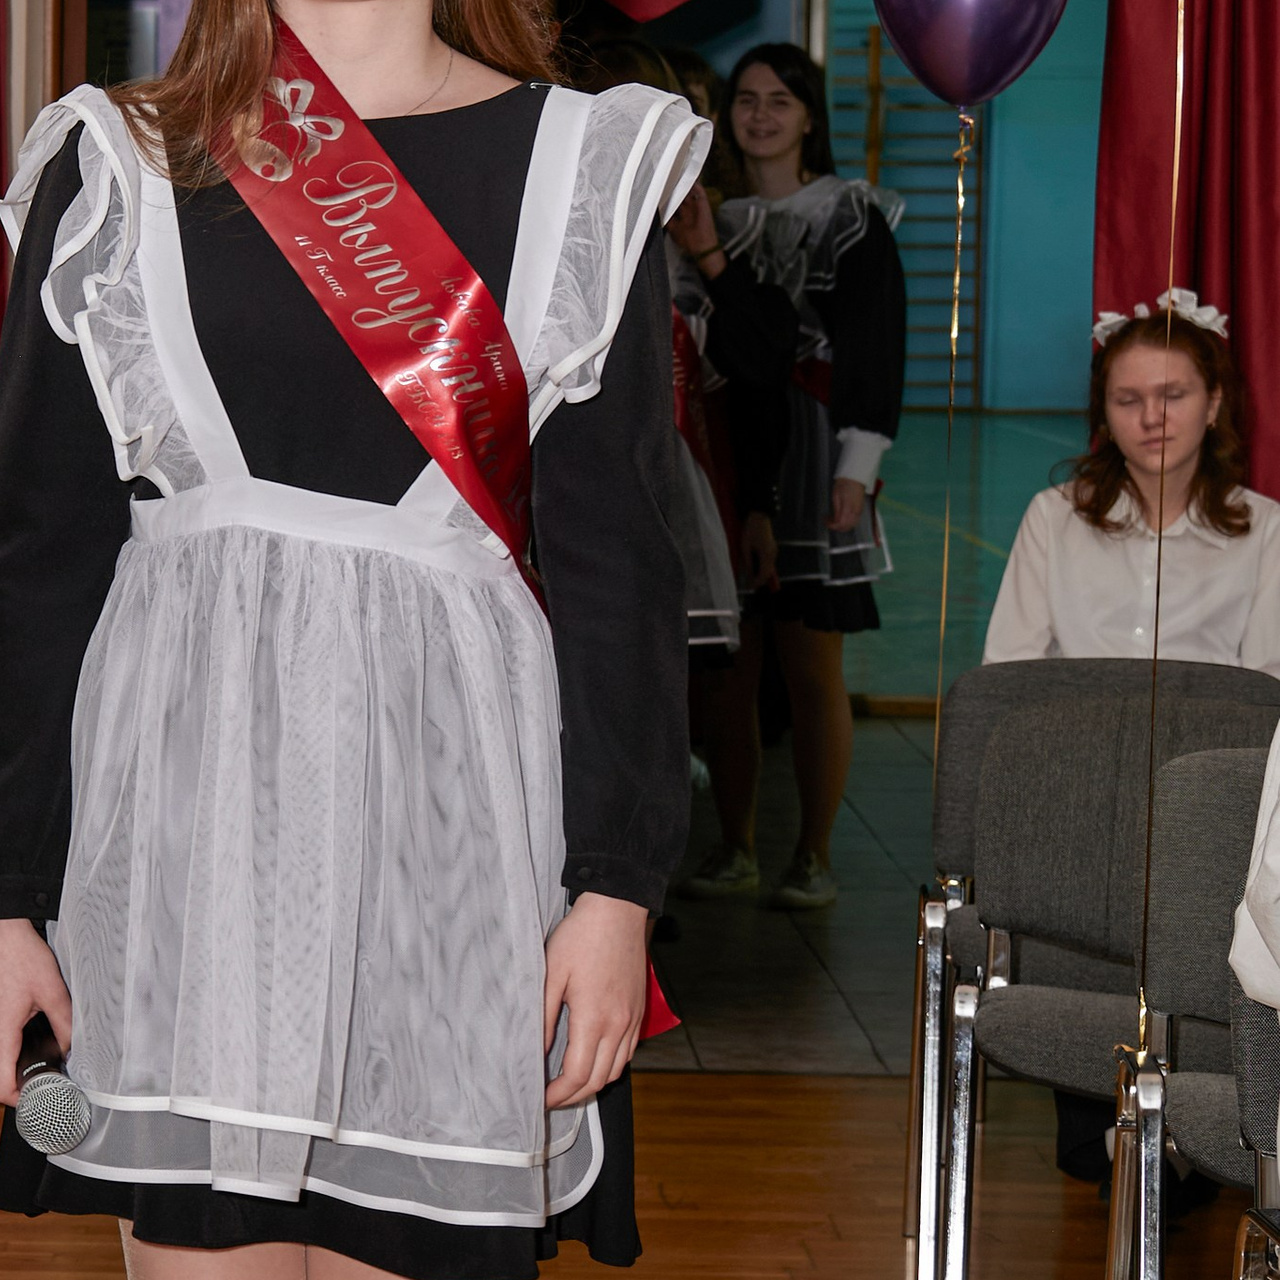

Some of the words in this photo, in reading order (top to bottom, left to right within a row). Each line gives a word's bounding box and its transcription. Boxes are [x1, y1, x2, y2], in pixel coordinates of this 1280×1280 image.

[294, 235, 313, 247] 11
[306, 246, 334, 262] Г
[316, 265, 347, 298] класс
